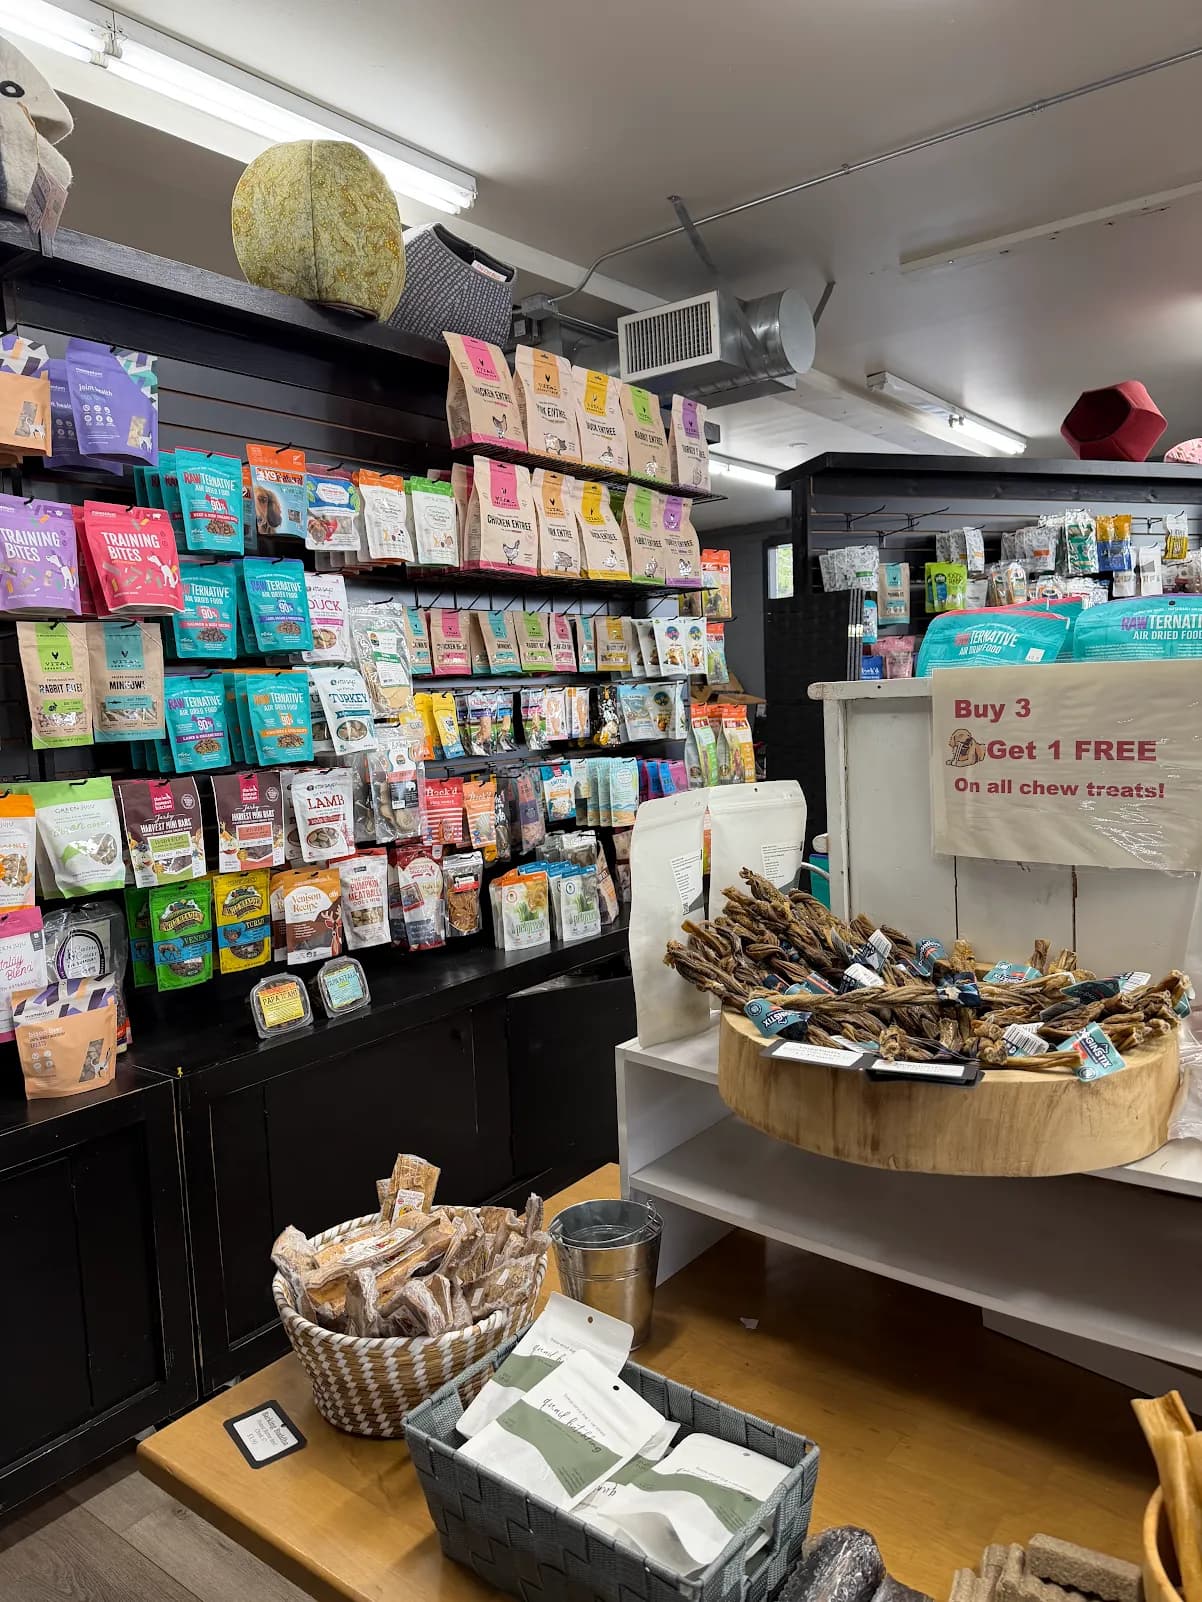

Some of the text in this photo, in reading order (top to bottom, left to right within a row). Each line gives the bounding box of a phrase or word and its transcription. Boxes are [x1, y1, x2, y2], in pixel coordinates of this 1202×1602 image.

[0, 528, 60, 548] TRAINING
[101, 532, 160, 548] TRAINING
[4, 542, 41, 562] BITES
[108, 545, 142, 562] BITES
[182, 584, 230, 598] WTERNATIVE
[1121, 614, 1202, 630] RAWTERNATI
[1133, 630, 1148, 640] AIR
[1152, 630, 1178, 640] DRIED
[328, 693, 368, 704] TURKEY
[954, 698, 1030, 723] Buy 3
[986, 740, 1157, 761] Get 1 FREE
[954, 778, 1165, 798] On all chew treats!
[307, 794, 345, 809] LAMB
[140, 818, 192, 833] HARVEST MINI BARS
[155, 812, 175, 823] Jerky
[292, 893, 322, 904] Venison
[293, 902, 318, 914] Recipe
[6, 961, 34, 980] Blend
[1074, 1026, 1113, 1068] OGGINSTIX
